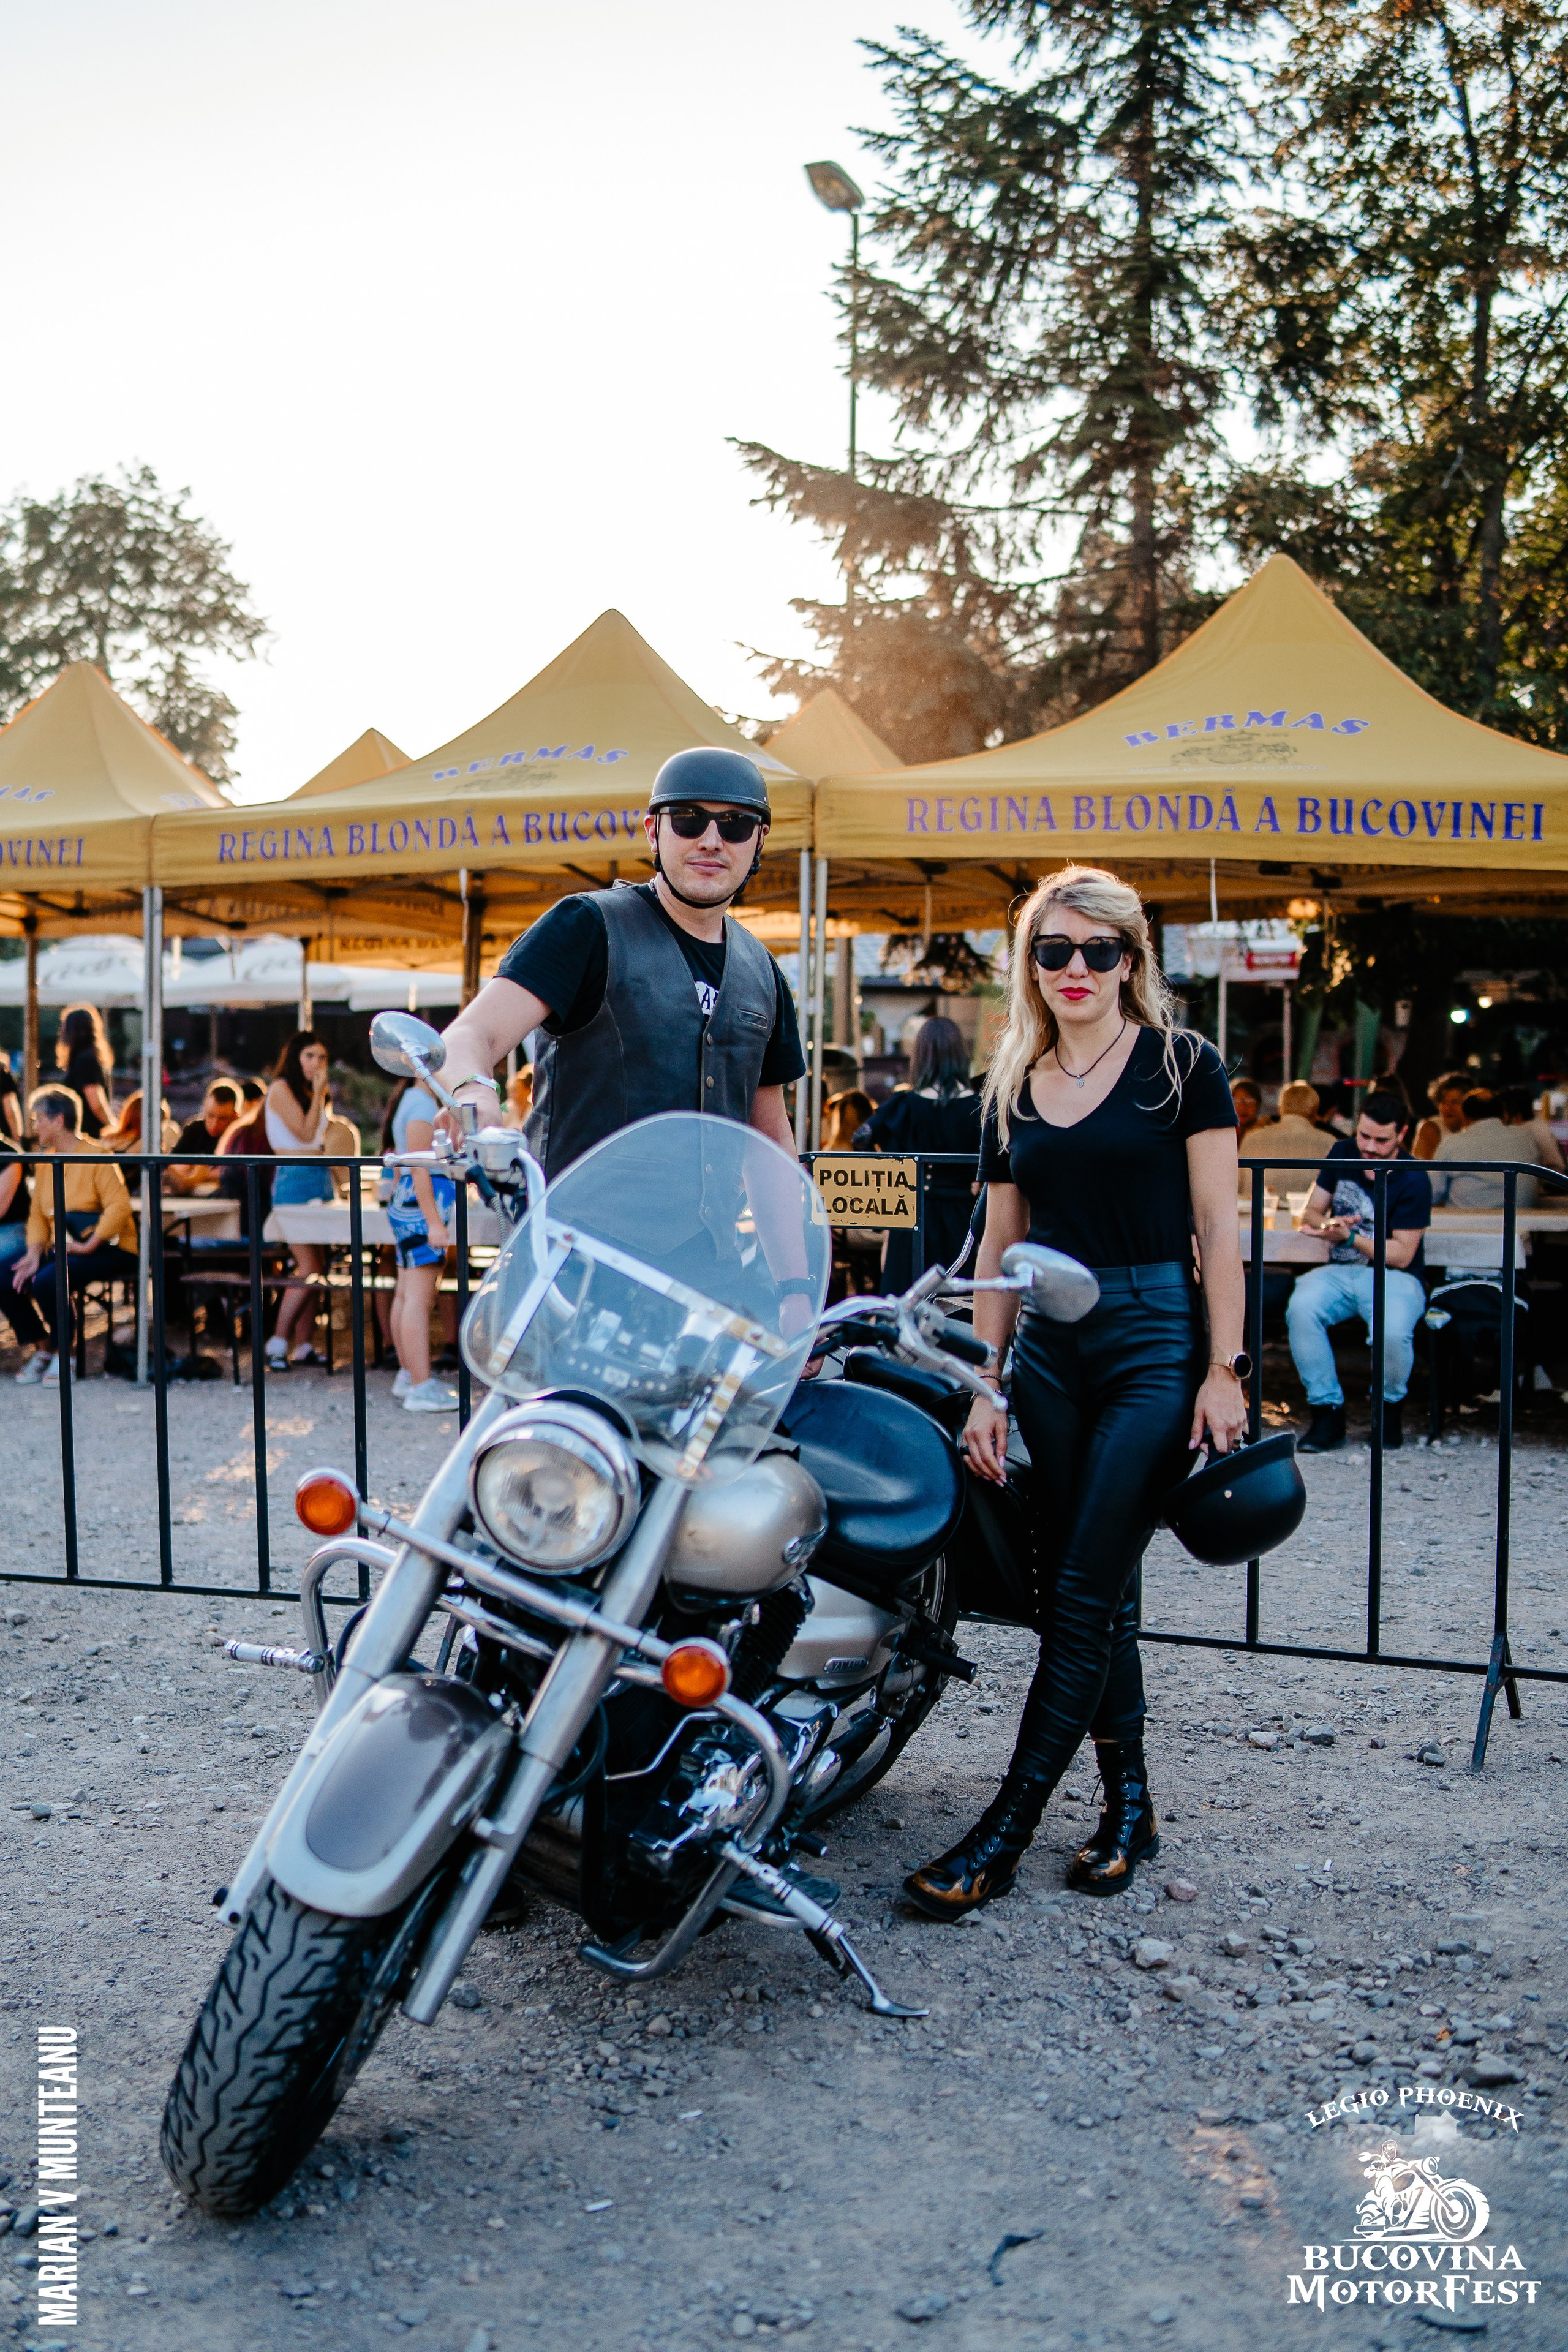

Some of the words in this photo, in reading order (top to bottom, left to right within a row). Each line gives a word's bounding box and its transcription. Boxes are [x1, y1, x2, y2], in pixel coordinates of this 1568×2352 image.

[219, 827, 335, 862] REGINA
[491, 814, 511, 846] A
[523, 809, 649, 844] BUCOV
[906, 796, 1058, 832] REGINA
[1254, 796, 1281, 832] A
[1296, 797, 1545, 841] BUCOVINEI
[0, 837, 83, 867] VINEI
[831, 1660, 867, 1673] YAMAHA
